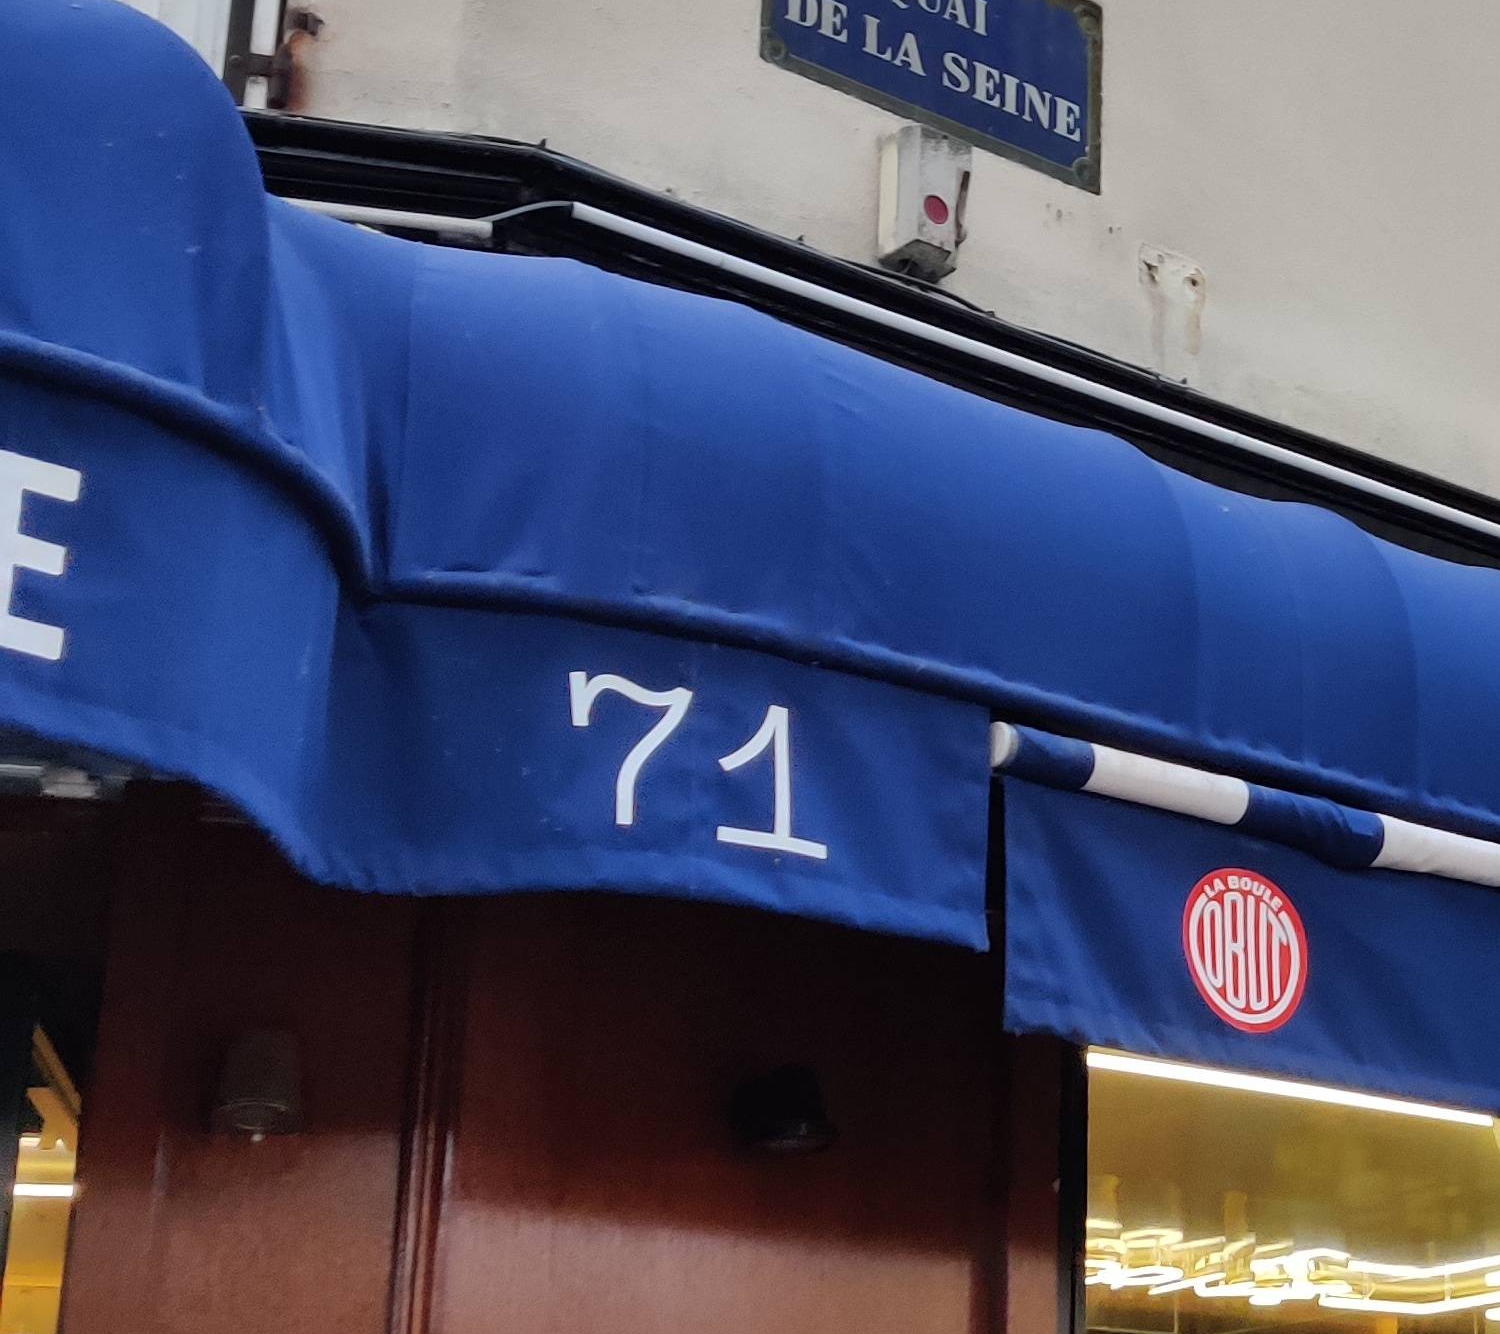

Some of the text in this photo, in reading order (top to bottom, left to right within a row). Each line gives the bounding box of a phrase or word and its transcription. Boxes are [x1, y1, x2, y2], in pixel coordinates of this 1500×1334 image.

[862, 13, 927, 77] LA
[941, 51, 1082, 142] SEINE
[568, 670, 828, 860] 71
[1202, 891, 1288, 1011] OBUT
[1203, 875, 1283, 912] LA BOULE
